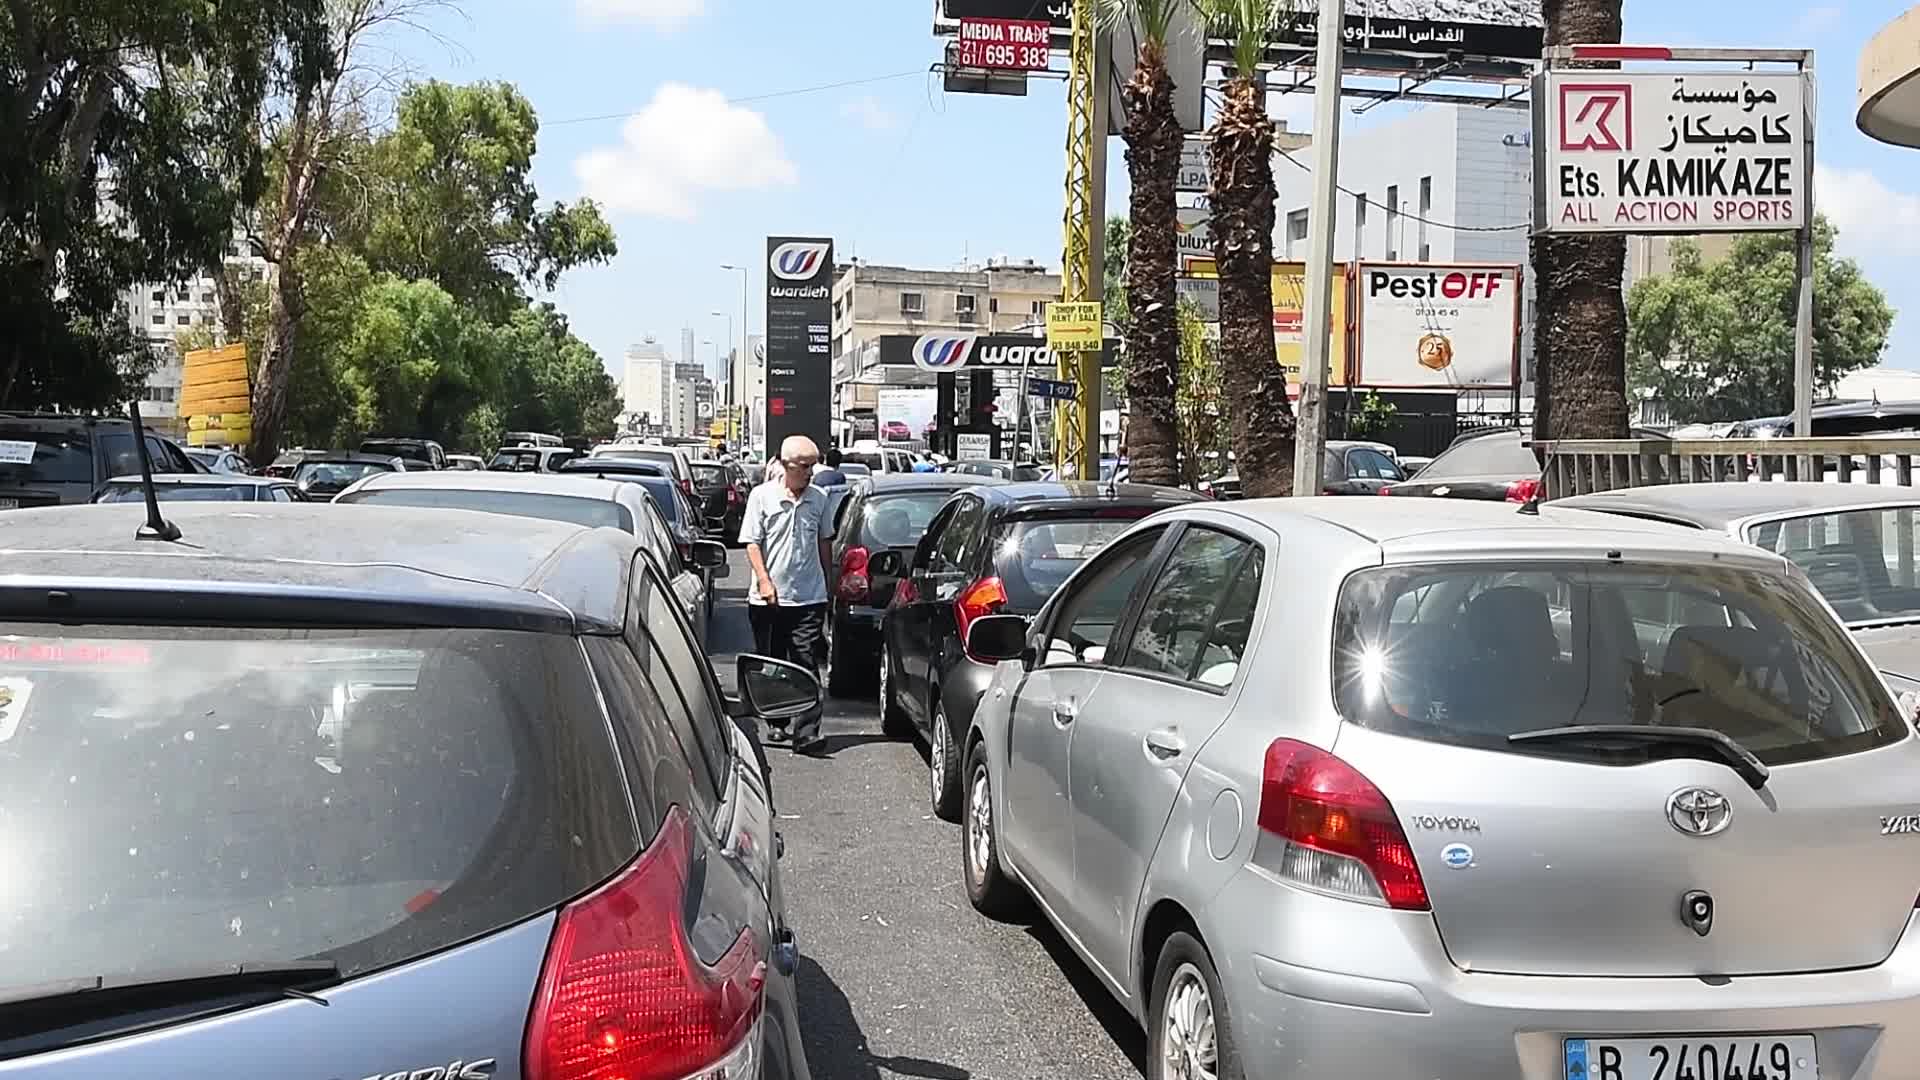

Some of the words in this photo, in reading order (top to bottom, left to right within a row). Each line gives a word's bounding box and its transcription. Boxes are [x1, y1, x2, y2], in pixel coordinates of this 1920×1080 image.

[962, 22, 1004, 41] MEDIA
[1008, 25, 1049, 44] TRADE
[1344, 24, 1407, 43] السنوي
[1410, 28, 1464, 44] القداس
[963, 41, 977, 51] 71
[985, 44, 1016, 66] 695
[1019, 47, 1048, 67] 383
[1671, 77, 1777, 112] مؤسسة
[1658, 113, 1792, 153] كاميكاز
[1560, 165, 1605, 198] Ets.
[1617, 158, 1792, 197] KAMIKAZE
[1561, 202, 1598, 223] ALL
[1614, 201, 1697, 222] ACTION
[1713, 200, 1793, 221] SPORTS
[770, 285, 829, 298] wardieh
[1412, 815, 1481, 832] TOYOTA
[1599, 1045, 1622, 1080] B
[1649, 1042, 1791, 1080] 240449
